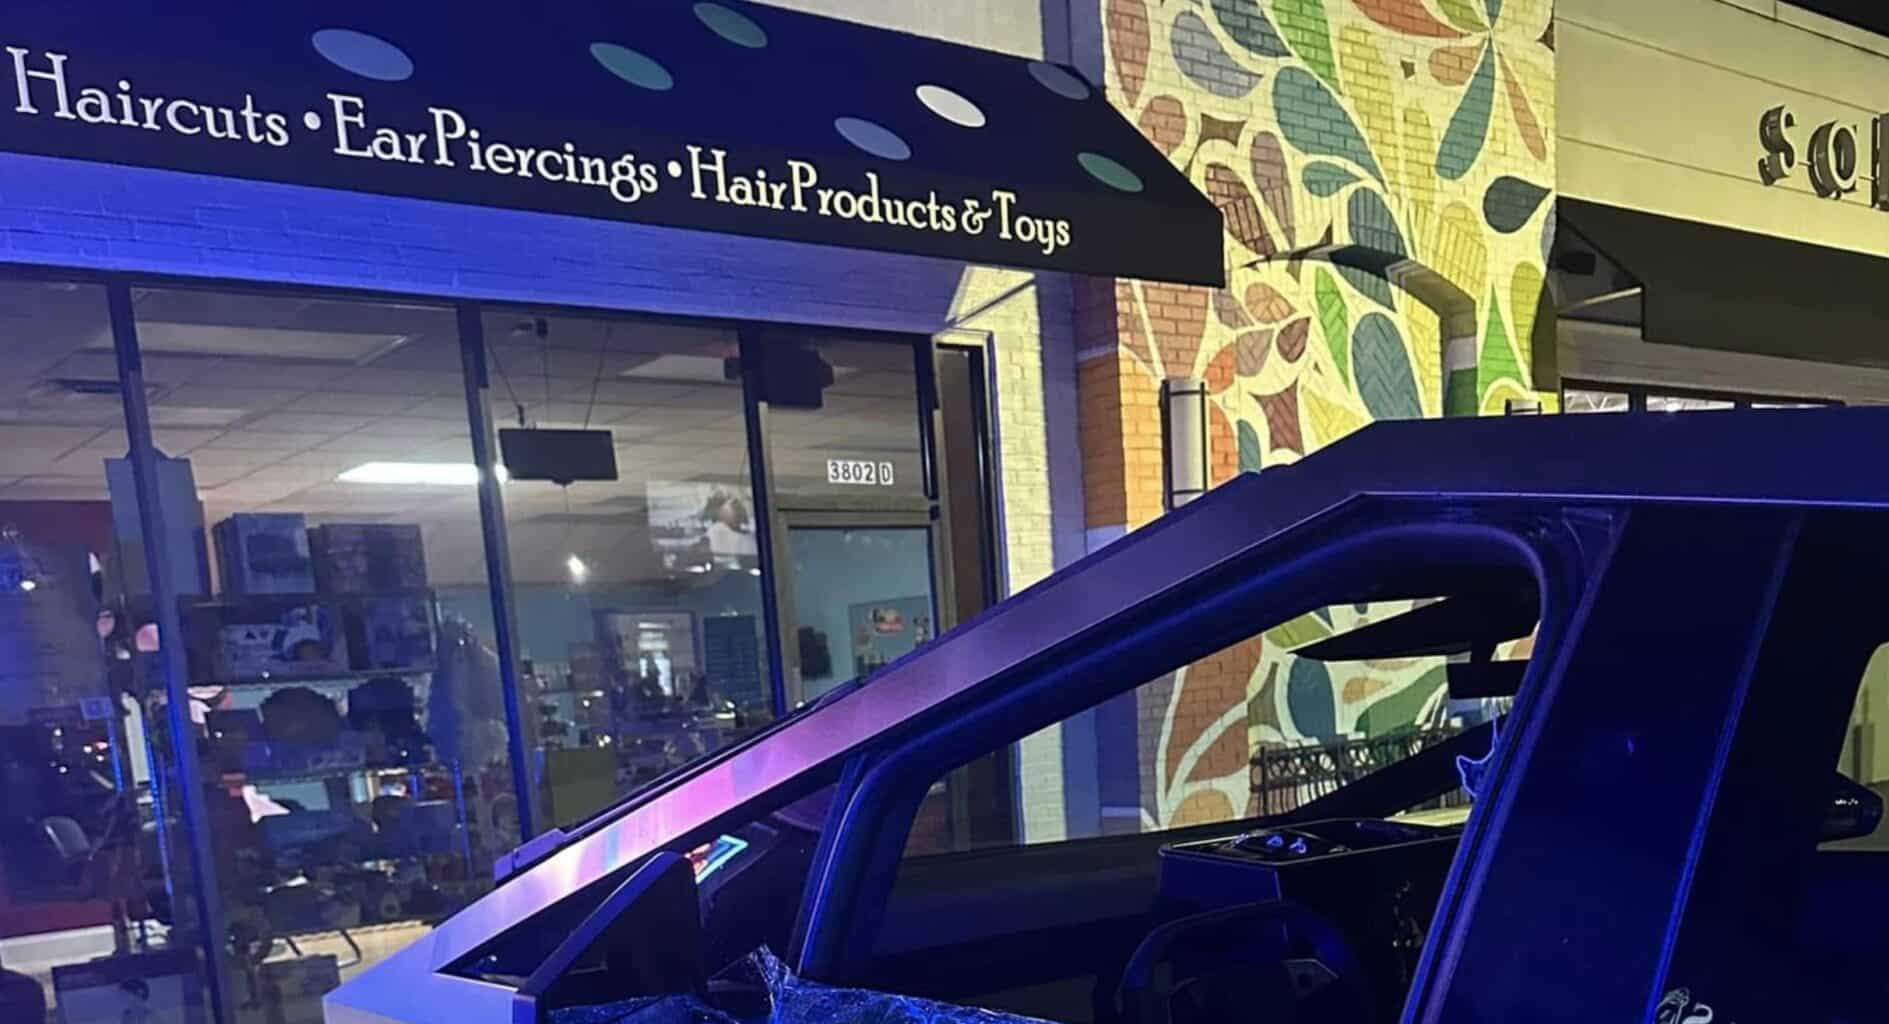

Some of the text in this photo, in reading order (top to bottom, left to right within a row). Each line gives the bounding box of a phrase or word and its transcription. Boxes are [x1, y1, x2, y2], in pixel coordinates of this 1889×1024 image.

[6, 46, 289, 147] Haircuts
[992, 189, 1071, 255] Toys
[1758, 104, 1889, 213] SO
[829, 461, 892, 482] 3802 D
